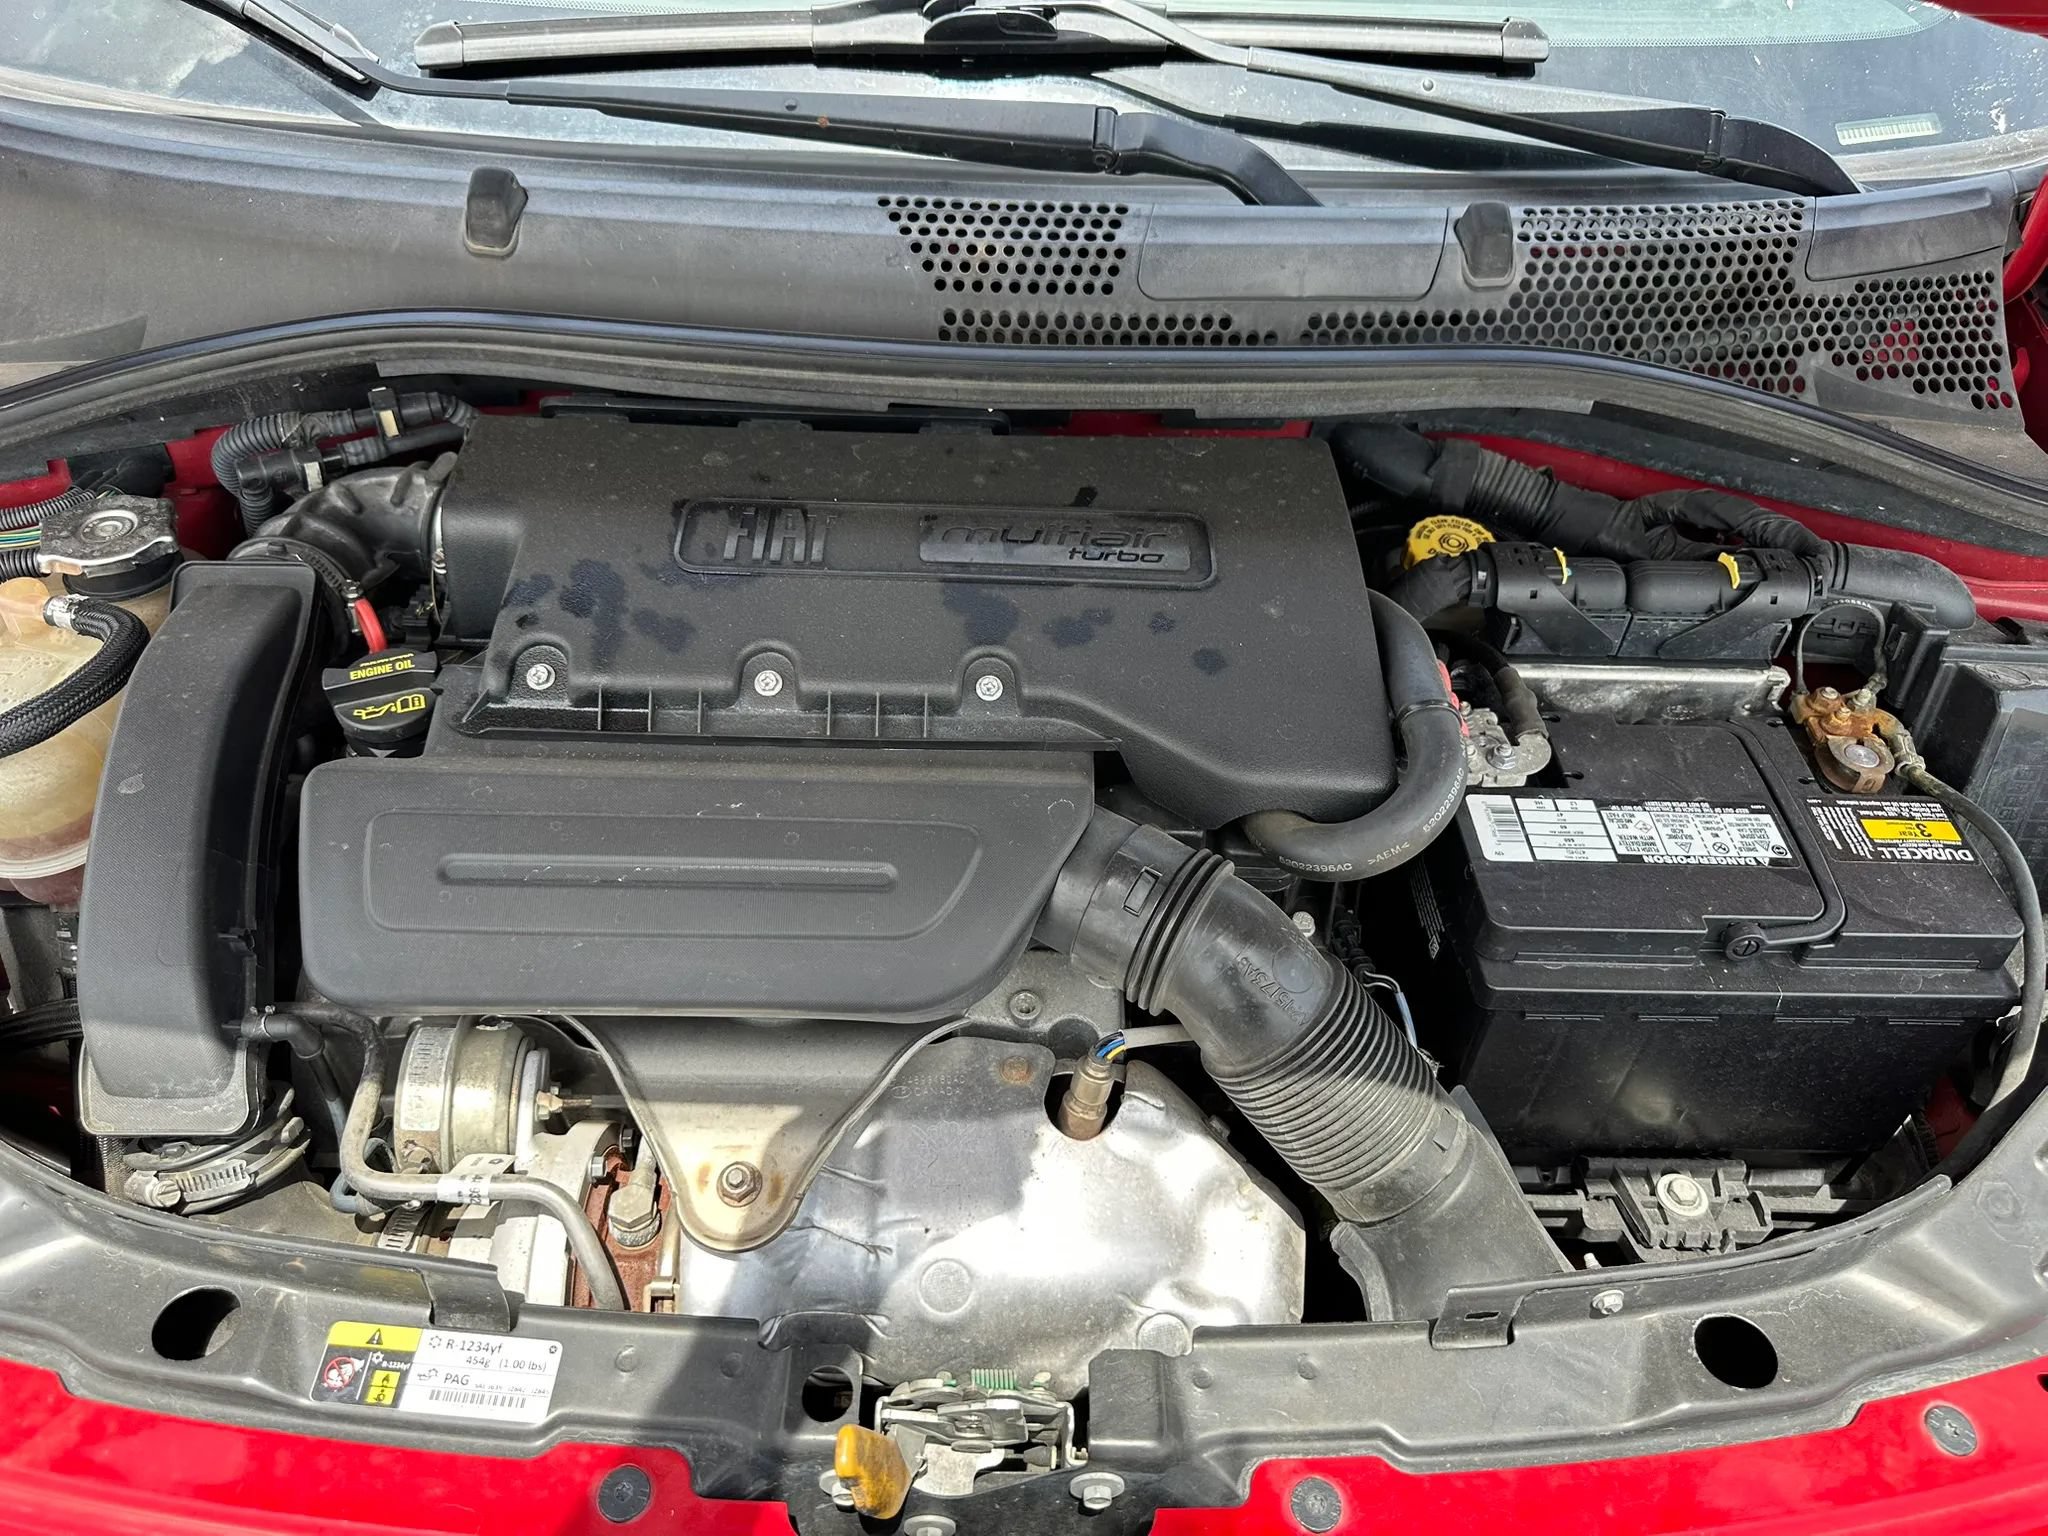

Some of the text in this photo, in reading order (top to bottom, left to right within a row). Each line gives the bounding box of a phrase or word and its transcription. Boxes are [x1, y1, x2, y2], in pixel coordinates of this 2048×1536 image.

[723, 505, 838, 563] FIAT
[942, 519, 1168, 548] multiair
[1068, 548, 1165, 564] turbo
[349, 663, 394, 681] ENGINE
[395, 659, 416, 671] OIL
[1915, 823, 1931, 837] 3
[1642, 855, 1757, 865] DANGER/POISON
[1876, 847, 1974, 861] DURACELL
[446, 1338, 503, 1356] R-1234yf
[465, 1355, 547, 1373] 454g (1.00 lbs)
[443, 1372, 471, 1386] PAG
